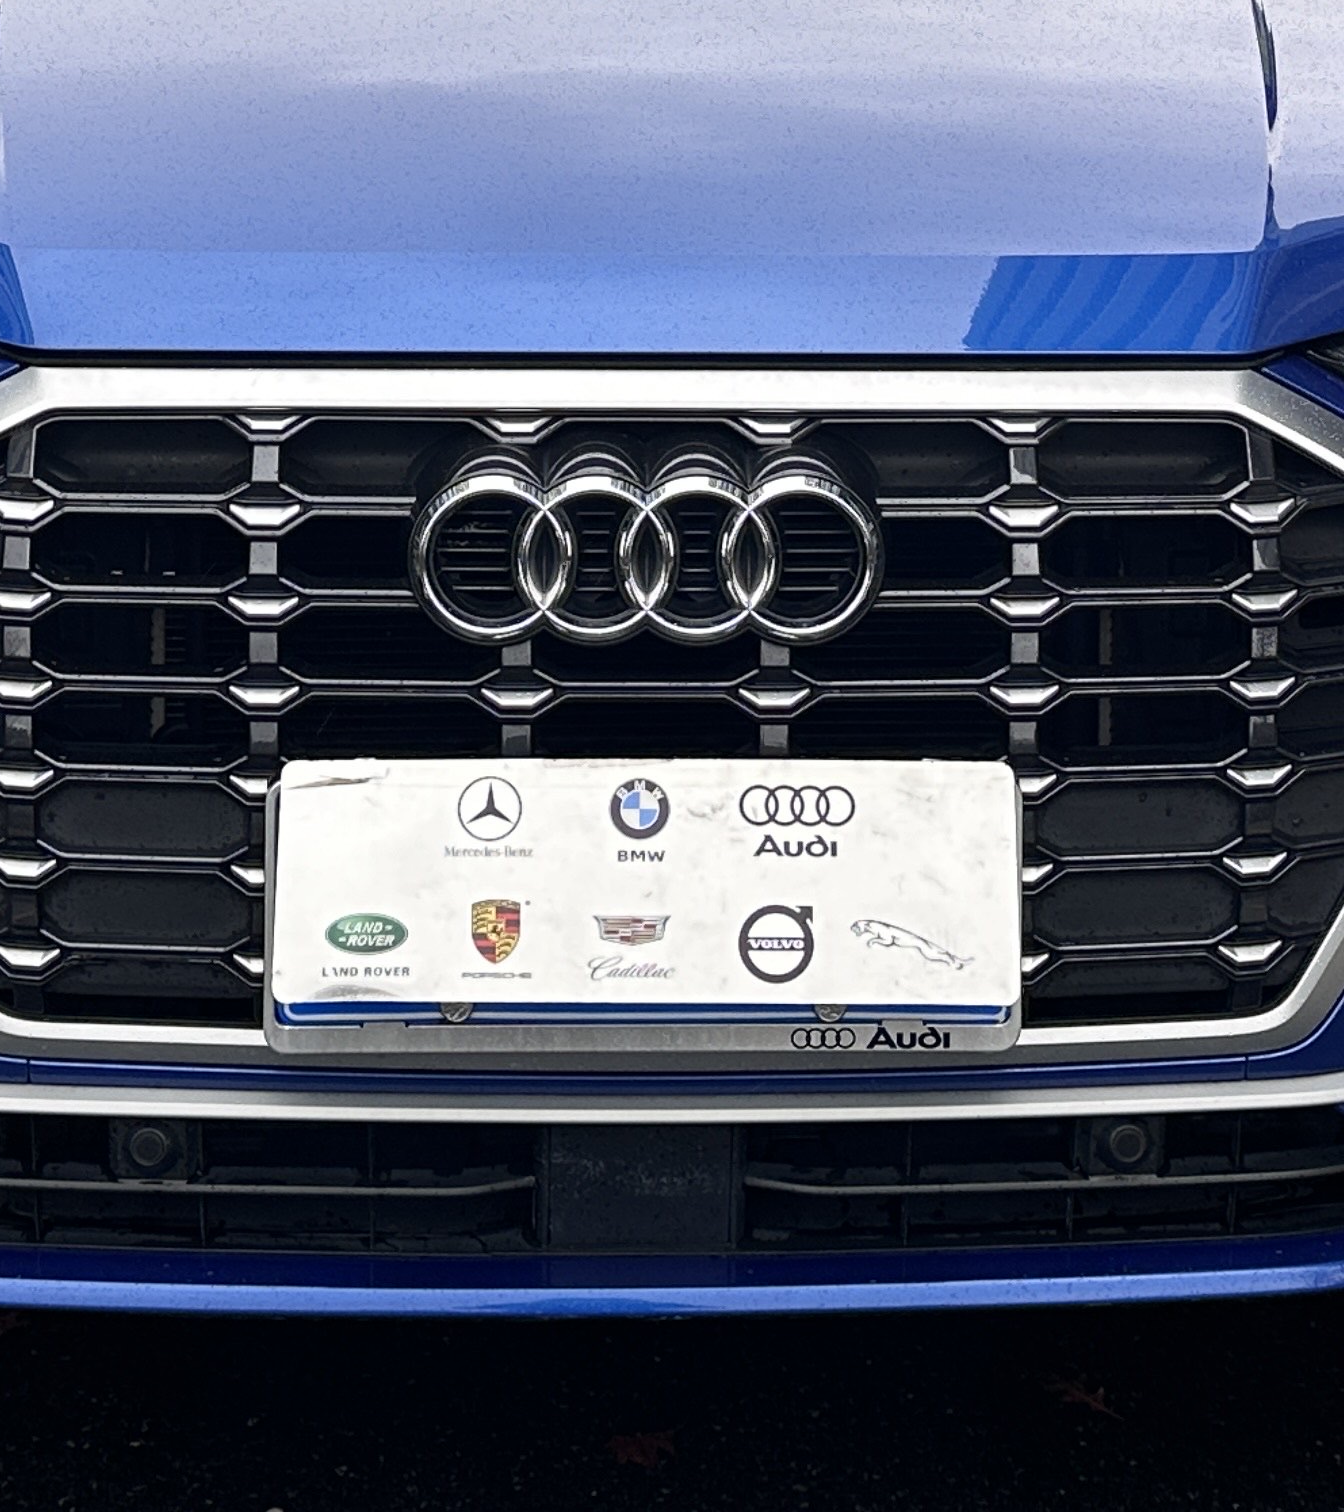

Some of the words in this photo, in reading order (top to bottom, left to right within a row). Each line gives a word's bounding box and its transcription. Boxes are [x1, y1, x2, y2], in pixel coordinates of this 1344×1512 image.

[616, 779, 664, 800] BMW
[753, 834, 838, 857] Audi
[617, 850, 665, 862] BMW
[343, 921, 383, 934] LAND
[346, 934, 395, 947] ROVER
[747, 938, 805, 950] VOLVO
[364, 967, 410, 978] ROVER
[587, 955, 675, 981] Cadillac
[866, 1026, 951, 1050] Audi
